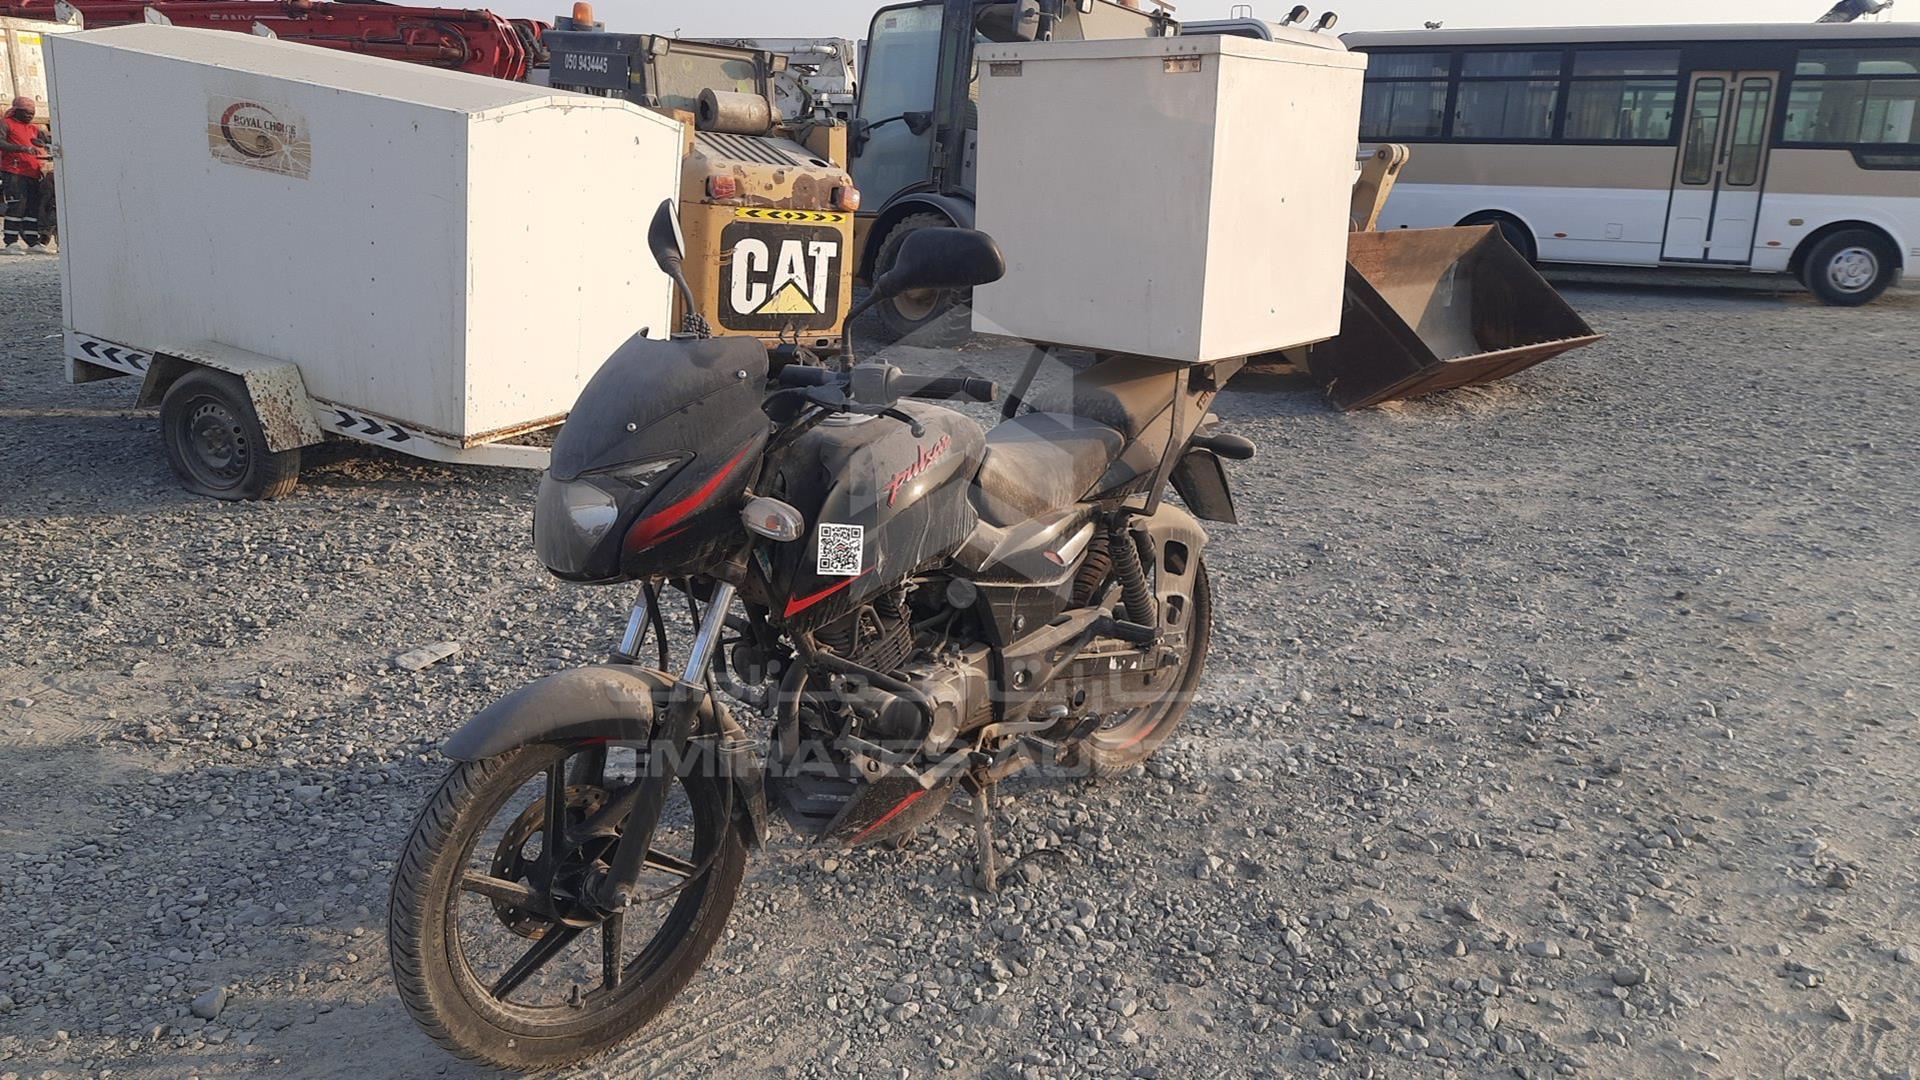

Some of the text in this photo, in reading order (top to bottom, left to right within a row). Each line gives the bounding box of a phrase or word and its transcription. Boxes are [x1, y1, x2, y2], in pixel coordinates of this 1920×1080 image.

[564, 53, 608, 74] 050 9434445
[233, 115, 297, 135] ROYAL CHOICE
[731, 238, 838, 315] CAT
